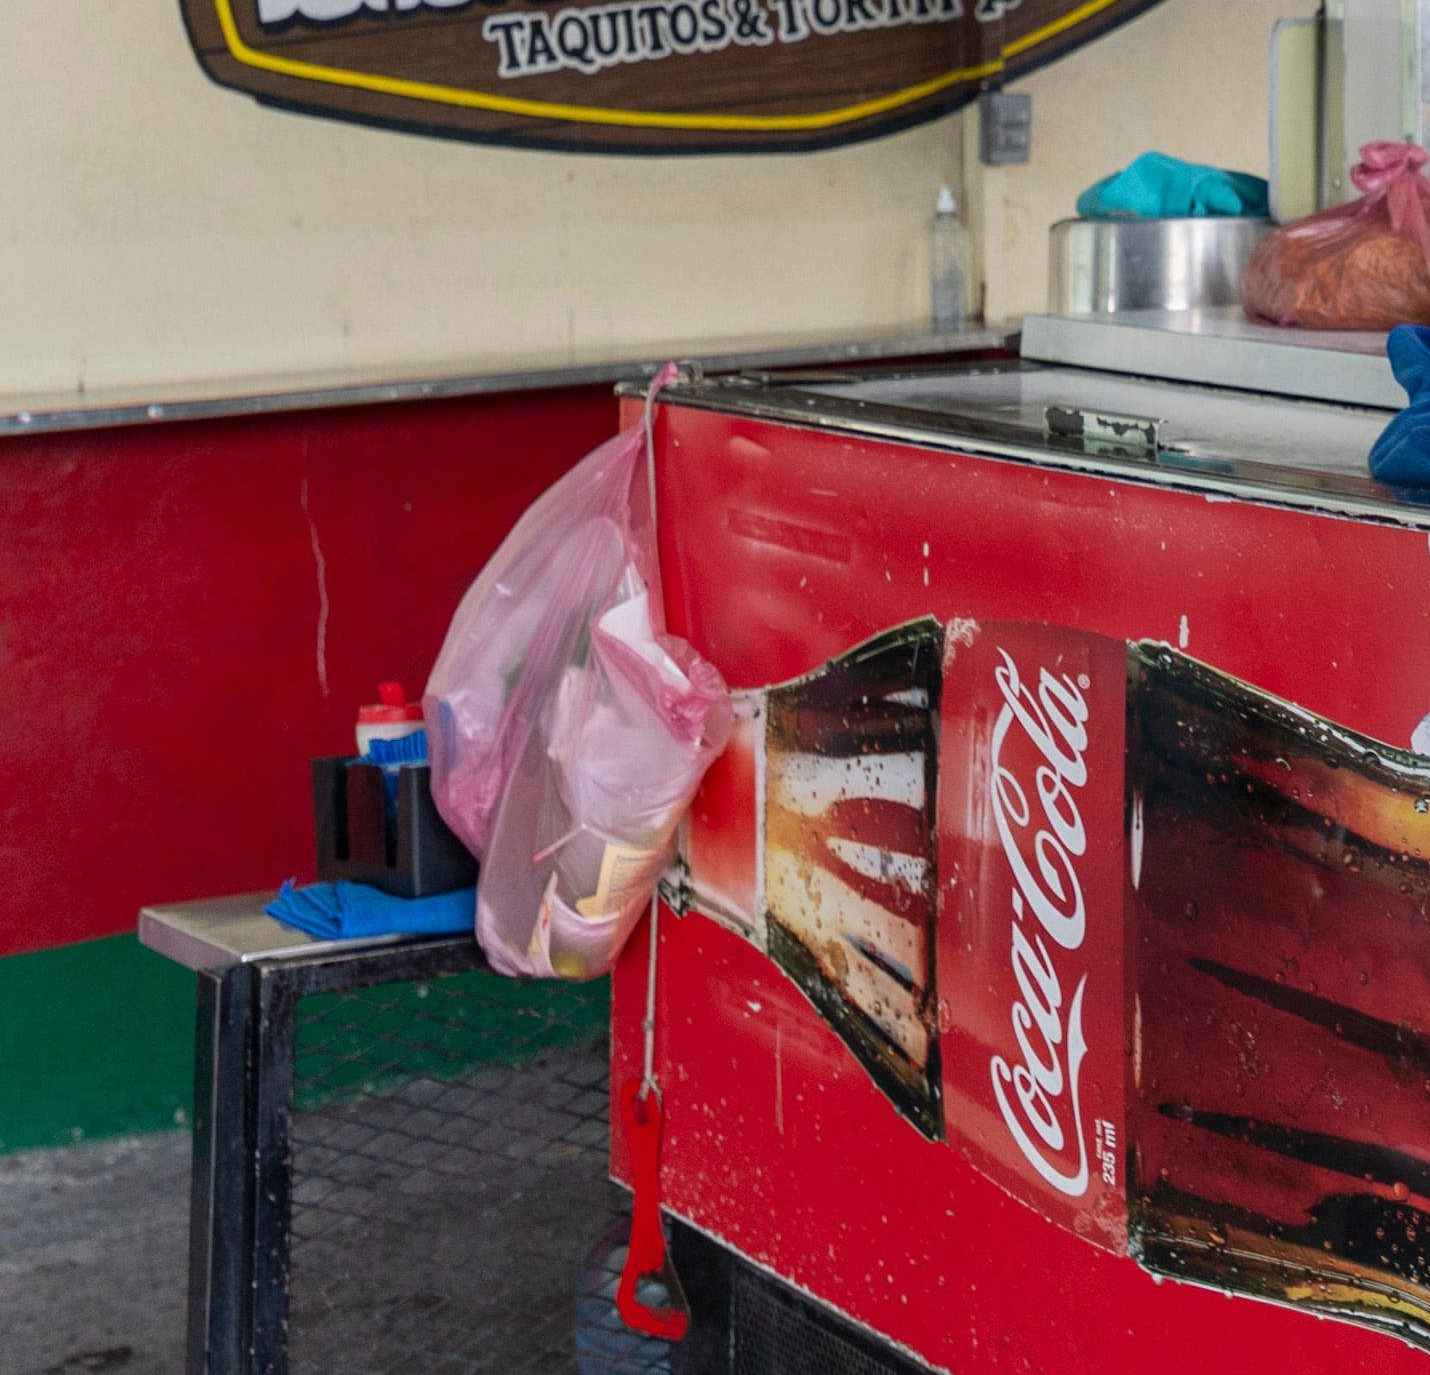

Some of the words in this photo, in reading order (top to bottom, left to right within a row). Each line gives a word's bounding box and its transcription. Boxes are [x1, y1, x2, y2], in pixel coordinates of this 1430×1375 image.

[991, 644, 1089, 1198] Coca-Cola
[1101, 1119, 1117, 1149] ml
[1101, 1150, 1117, 1187] 235
